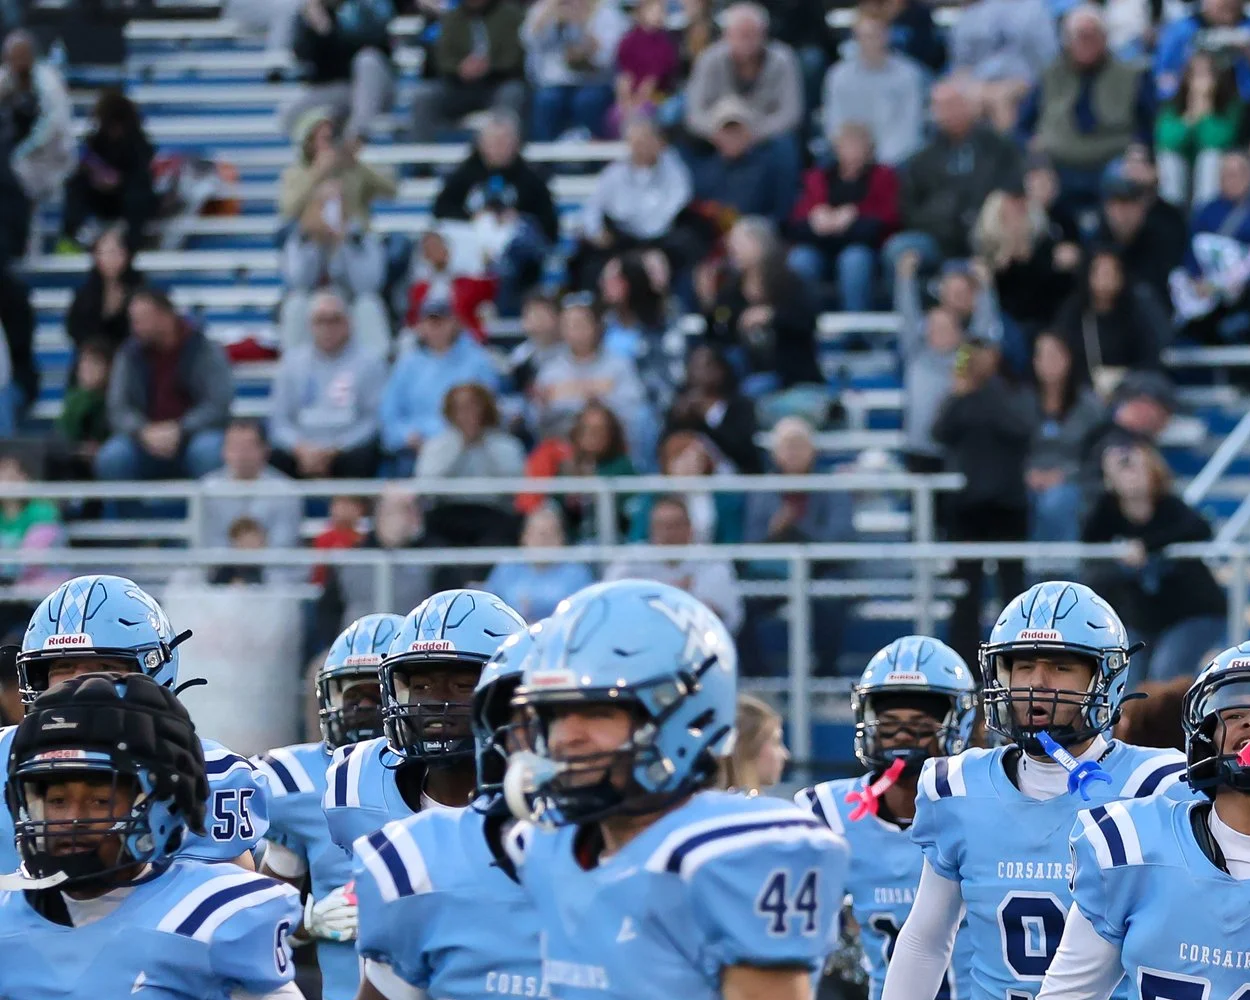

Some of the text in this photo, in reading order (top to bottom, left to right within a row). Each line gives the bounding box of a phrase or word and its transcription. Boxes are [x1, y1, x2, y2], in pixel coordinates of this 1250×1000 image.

[1020, 631, 1058, 640] Riddell
[411, 642, 450, 651] Riddell
[211, 787, 255, 842] 55
[997, 860, 1074, 880] CORSAIRS
[756, 868, 824, 935] 44
